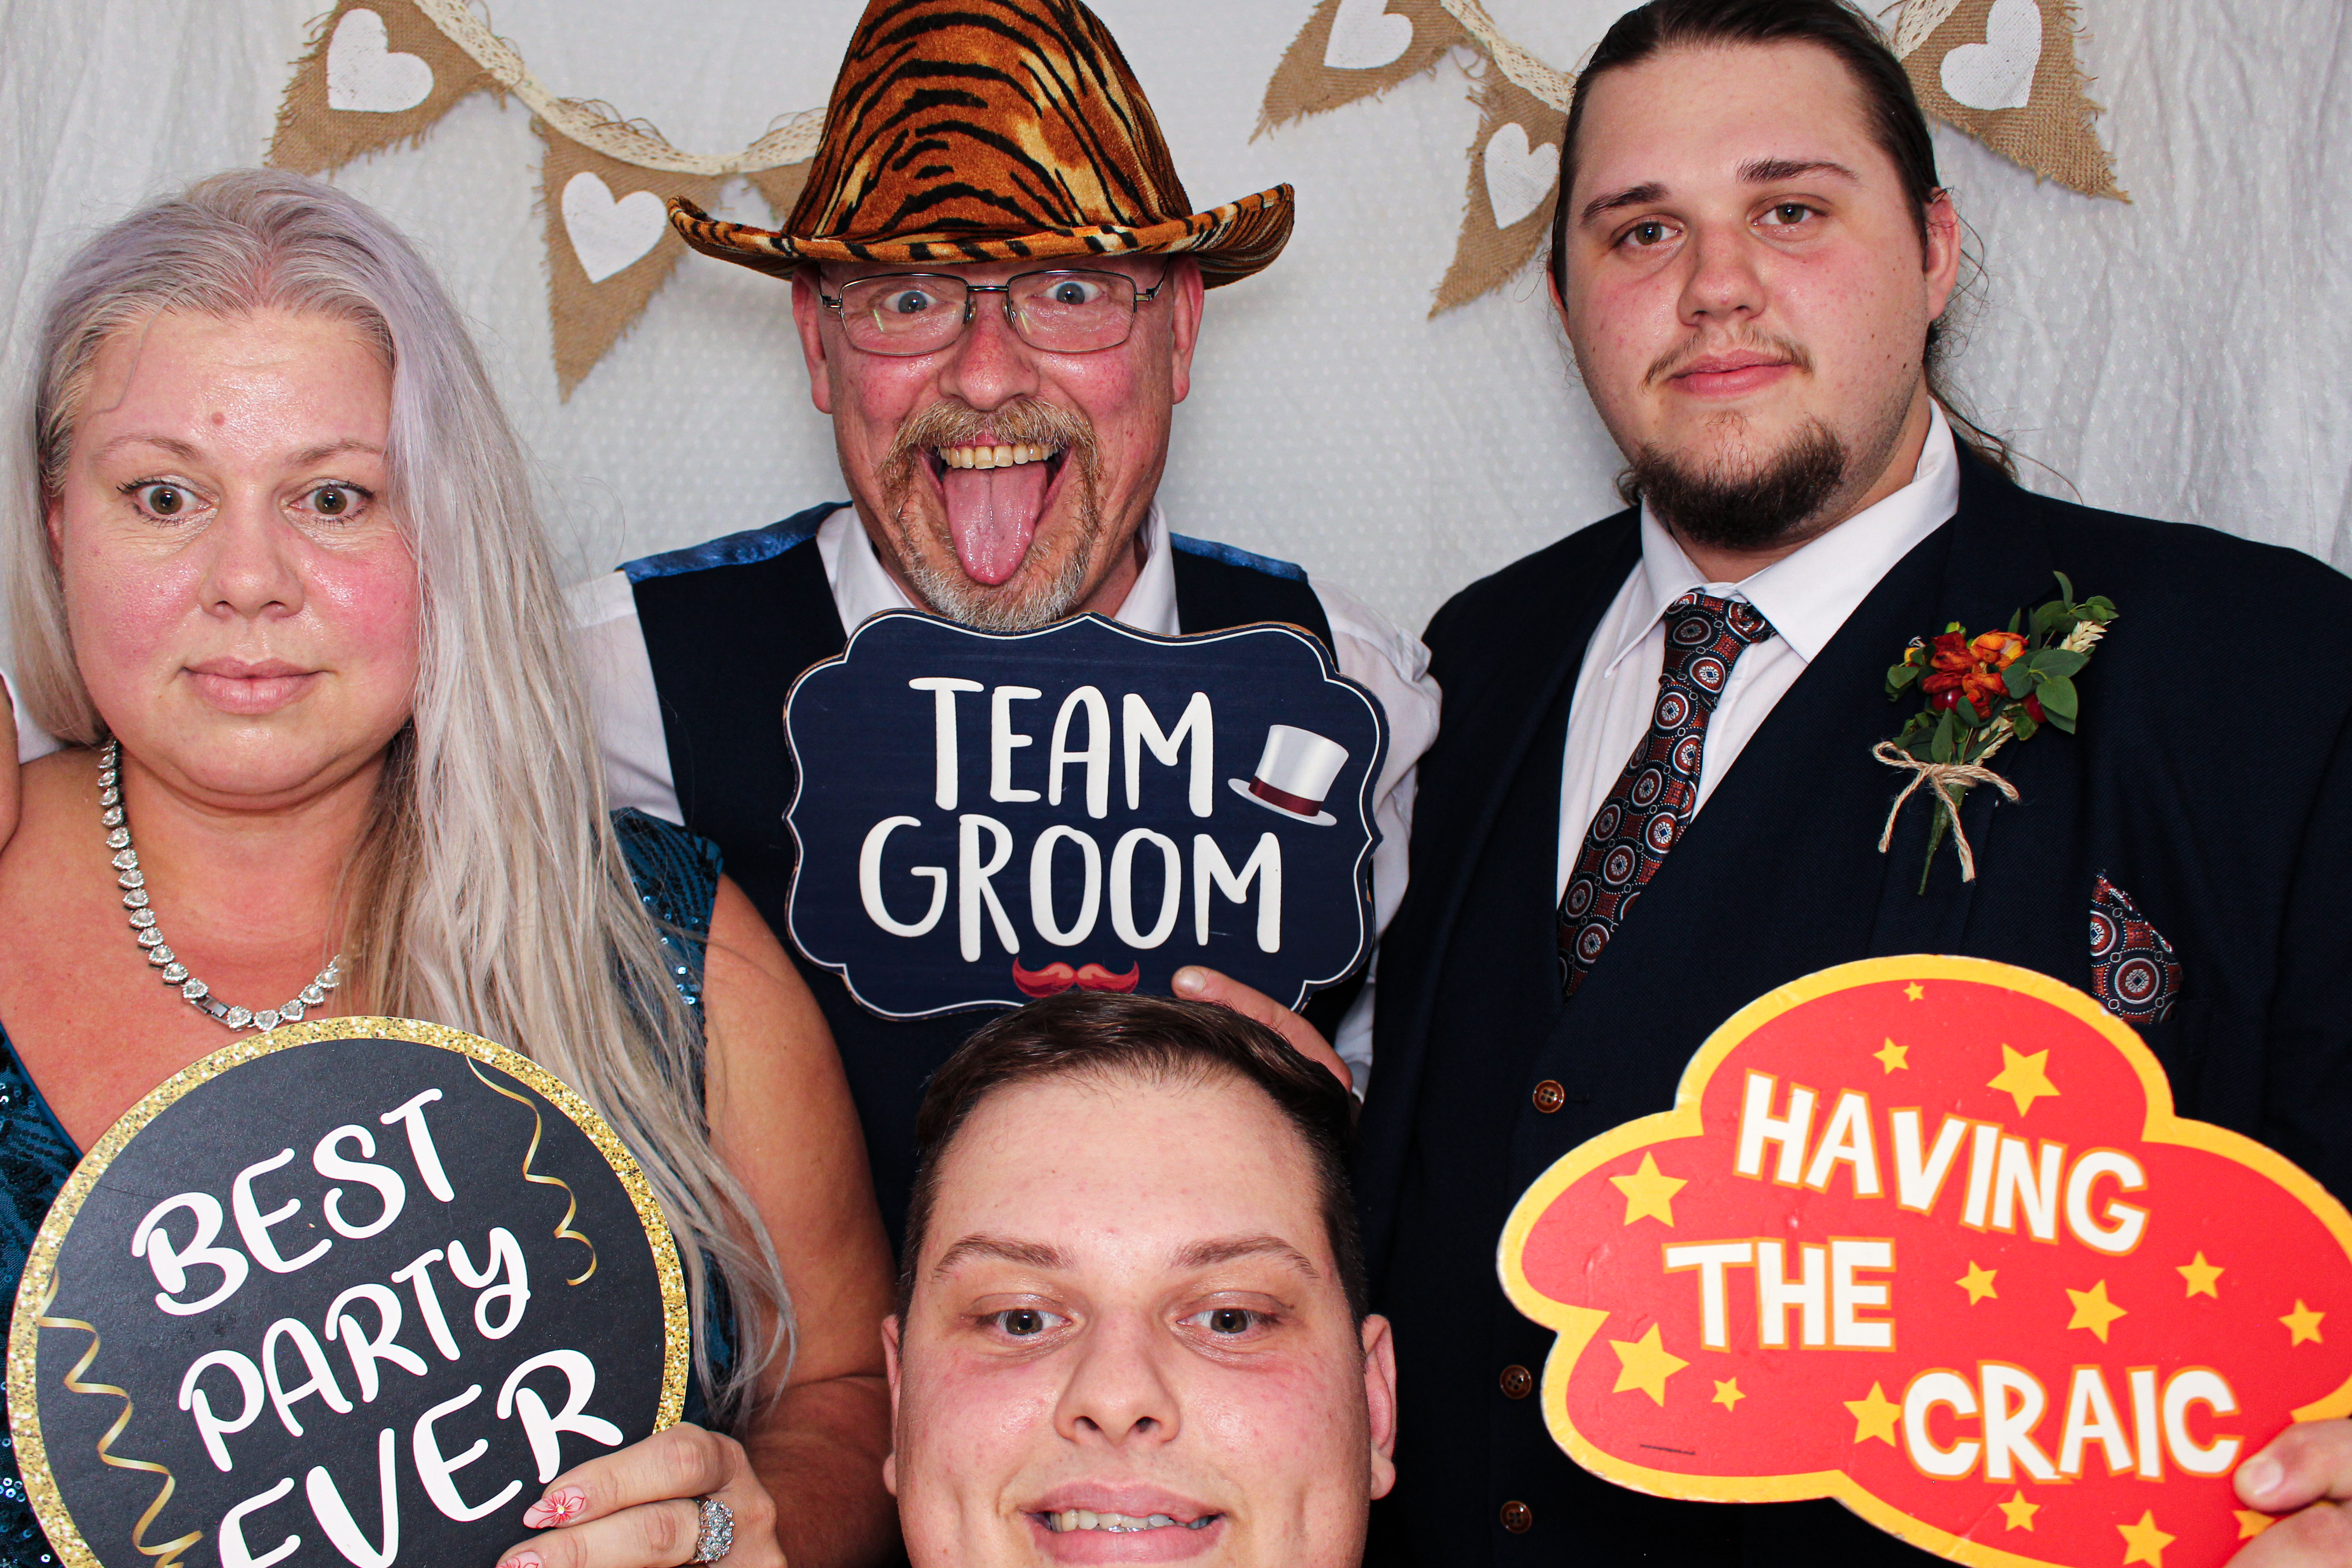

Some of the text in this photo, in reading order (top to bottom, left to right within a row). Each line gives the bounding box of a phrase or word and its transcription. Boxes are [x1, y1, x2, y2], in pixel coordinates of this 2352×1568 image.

[908, 676, 1214, 819] TEAM
[859, 813, 1282, 962] GROOM
[131, 1088, 455, 1316] BEST
[1737, 1073, 2146, 1253] HAVING
[178, 1226, 531, 1472] PARTY
[1665, 1239, 1893, 1348] THE
[1903, 1364, 2240, 1480] CRAIC
